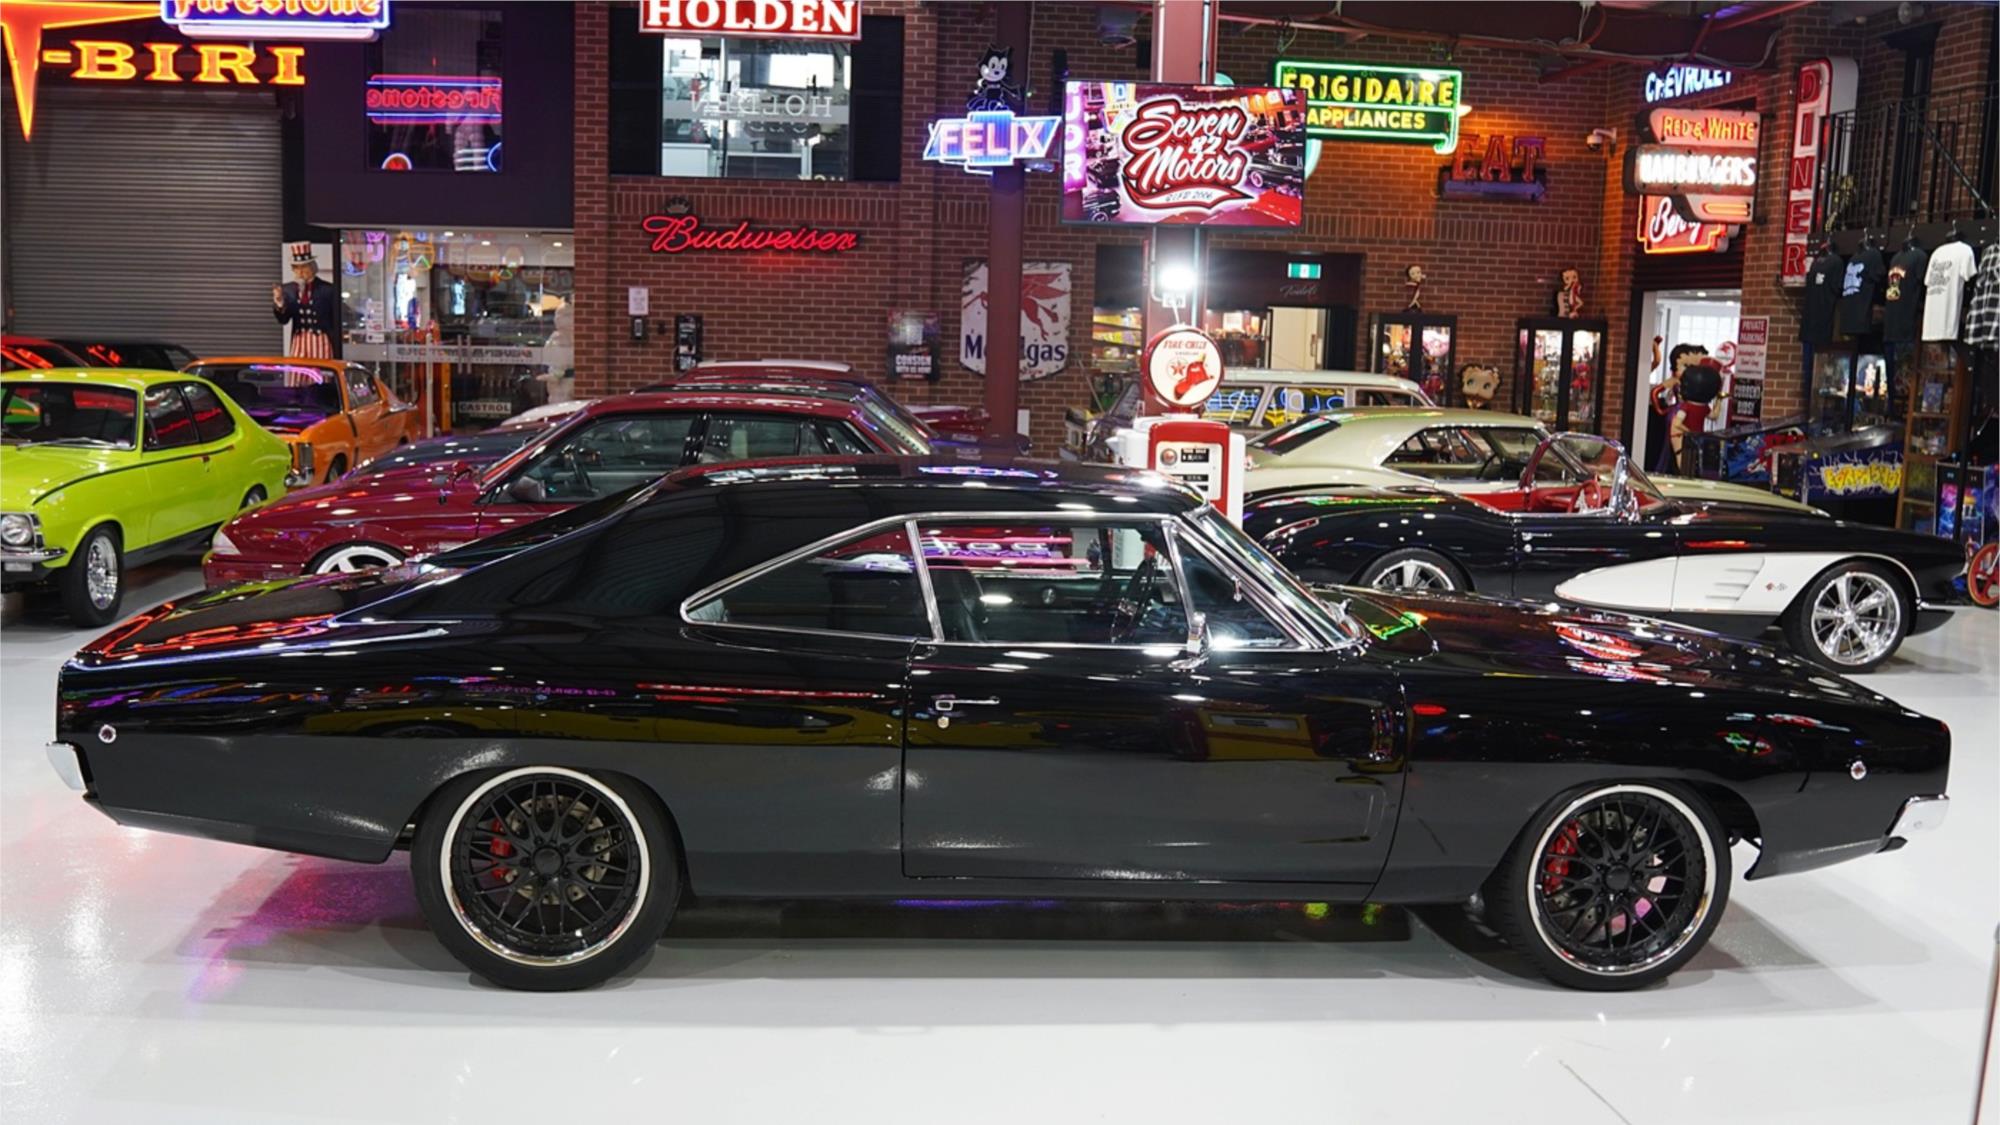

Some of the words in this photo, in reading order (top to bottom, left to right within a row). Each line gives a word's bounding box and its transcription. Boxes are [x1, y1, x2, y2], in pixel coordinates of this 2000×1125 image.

[647, 0, 854, 32] HOLDEN
[1282, 73, 1455, 107] FRIGIDAIRE
[1129, 104, 1241, 150] Seven
[1307, 108, 1426, 130] APPLIANCES
[1663, 116, 1689, 134] RED
[1707, 116, 1755, 141] WHITE
[940, 121, 1045, 156] FELIX
[1129, 146, 1242, 194] Motors
[1452, 134, 1546, 183] EAT
[1639, 153, 1756, 186] HAMBURGERS
[642, 215, 857, 252] Budweiser
[459, 402, 510, 413] CASTROL
